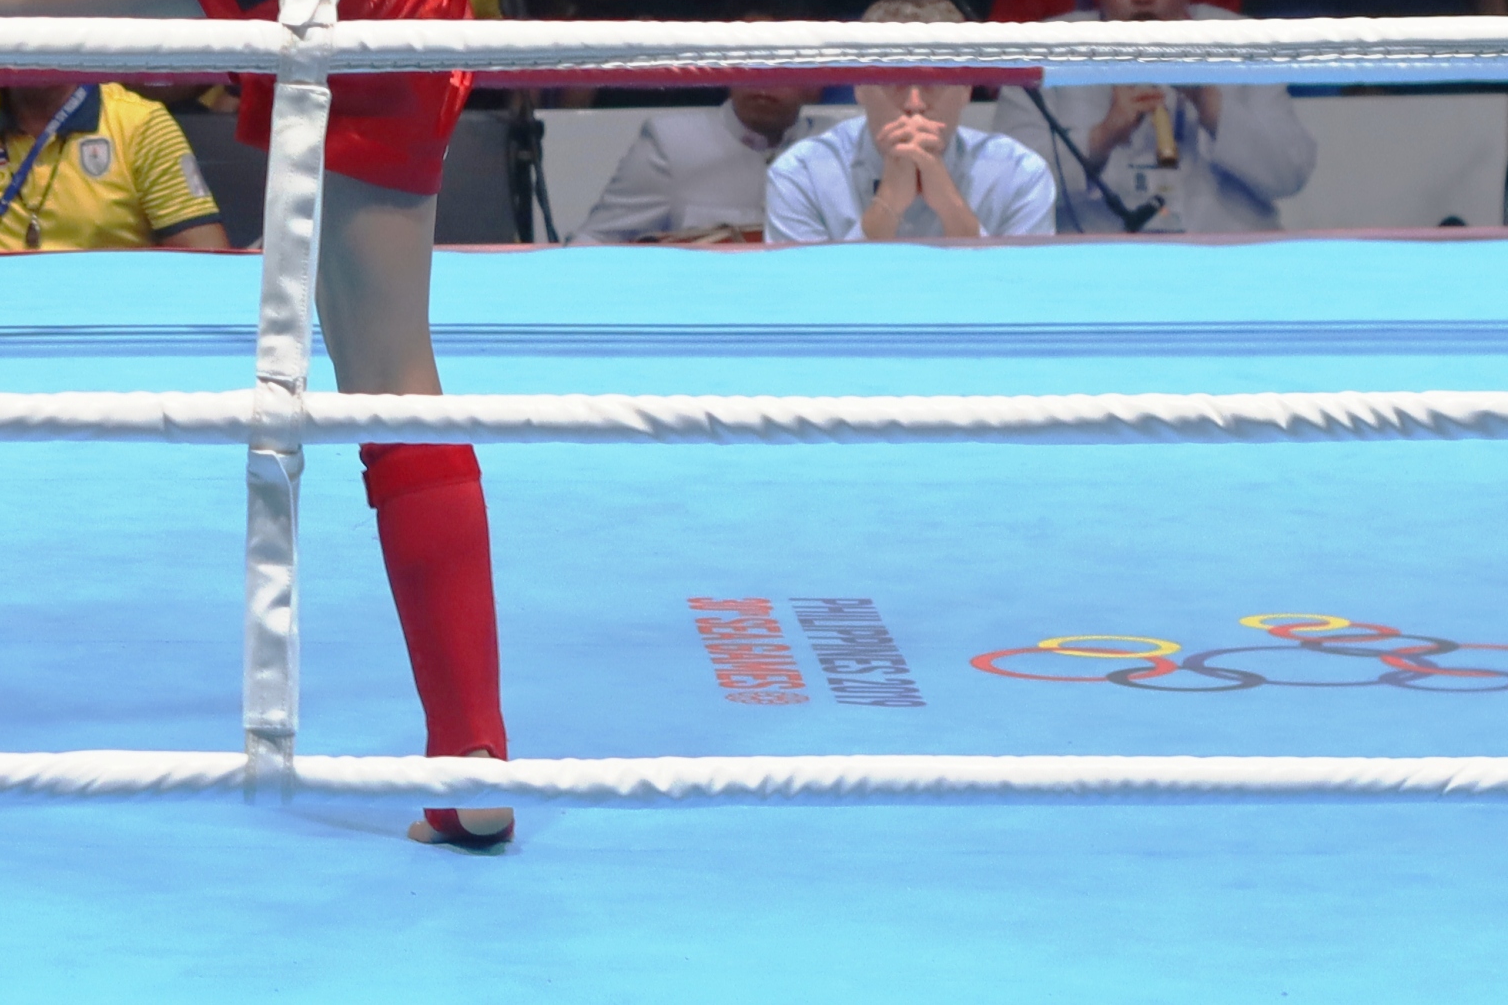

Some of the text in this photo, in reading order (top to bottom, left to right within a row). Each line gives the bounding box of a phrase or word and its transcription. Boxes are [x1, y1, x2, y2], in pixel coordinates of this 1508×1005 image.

[694, 616, 785, 641] SEA
[704, 643, 807, 690] GAMES
[788, 597, 928, 708] PHILIPPINES 2019
